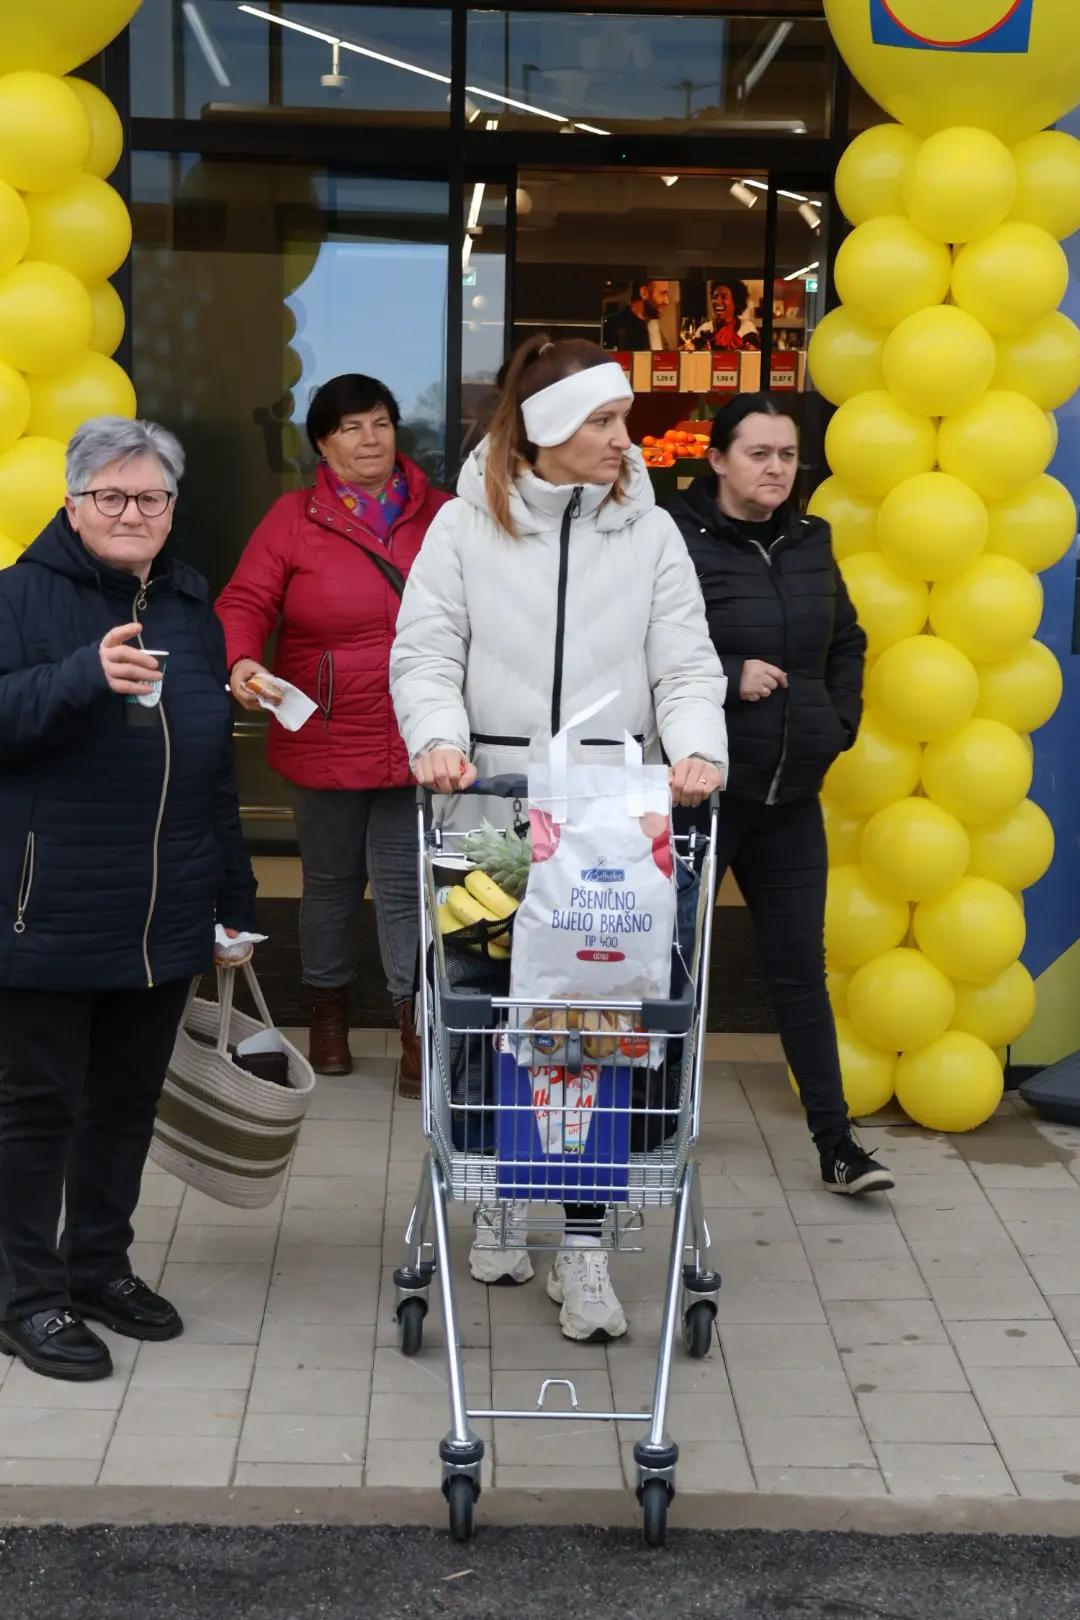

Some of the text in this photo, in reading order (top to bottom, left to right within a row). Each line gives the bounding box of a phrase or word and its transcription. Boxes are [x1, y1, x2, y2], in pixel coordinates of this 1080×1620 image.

[570, 886, 636, 911] PŠENIČNO
[552, 909, 652, 933] BIJELO BRAŠNO
[585, 934, 619, 948] TIP 400
